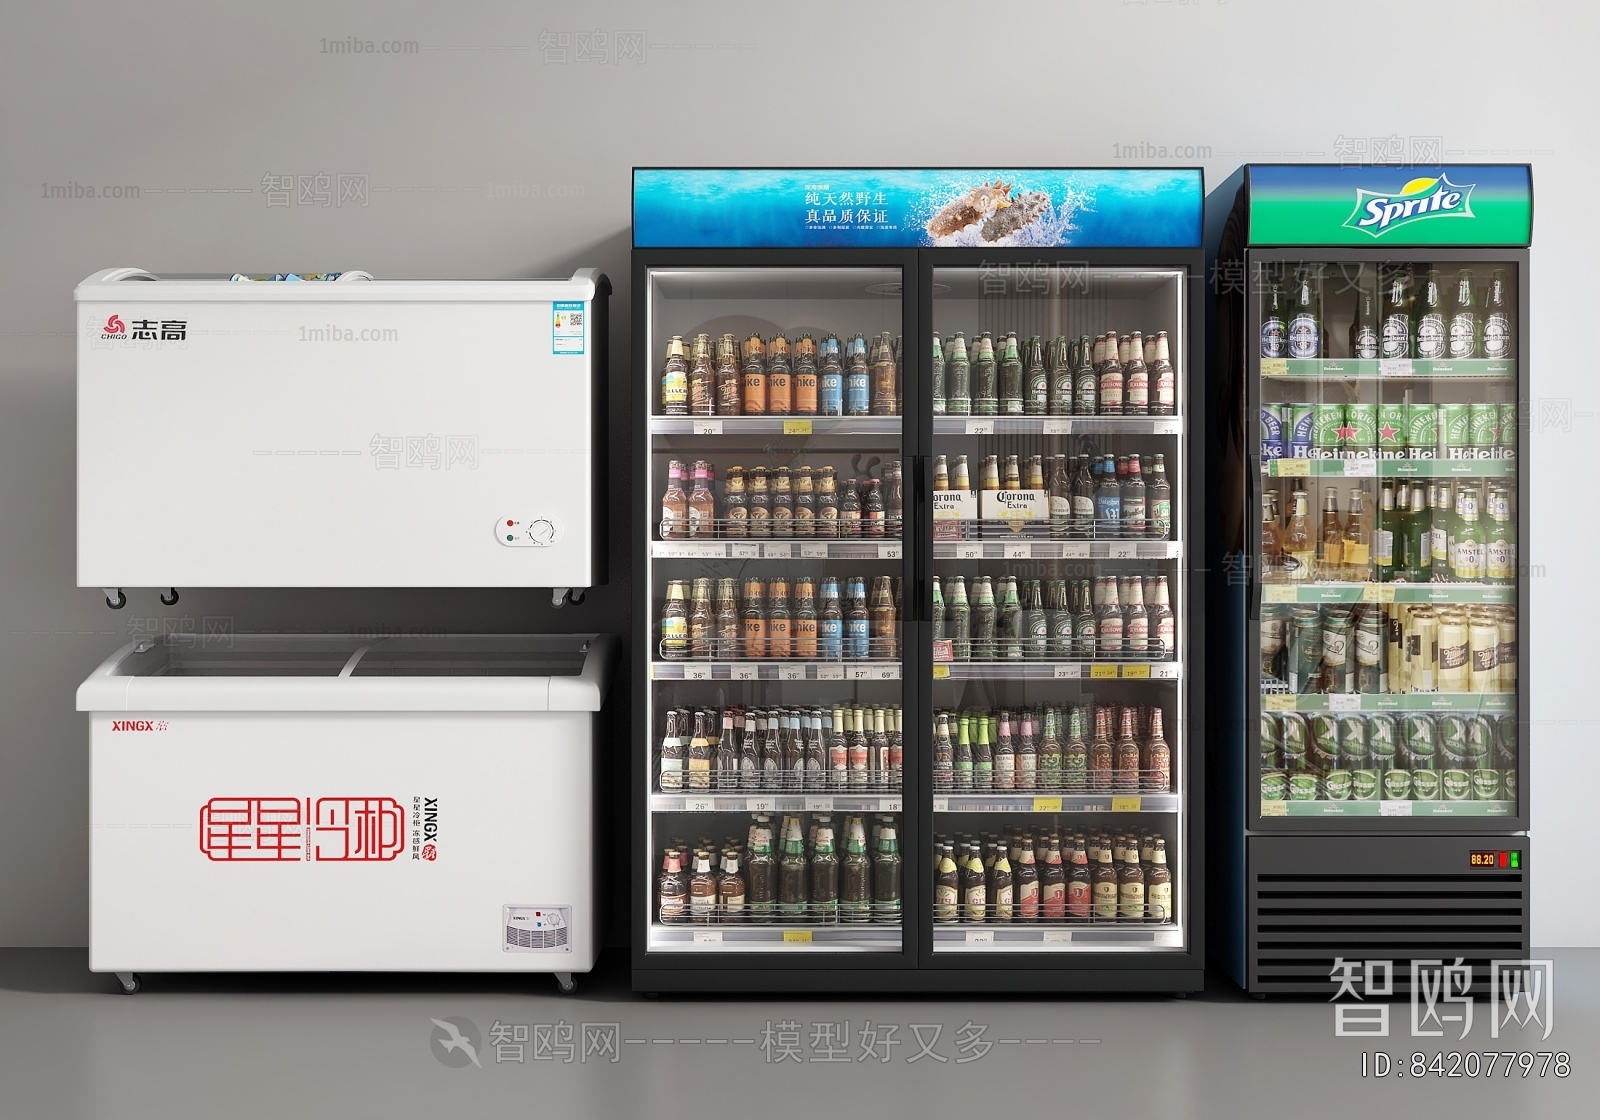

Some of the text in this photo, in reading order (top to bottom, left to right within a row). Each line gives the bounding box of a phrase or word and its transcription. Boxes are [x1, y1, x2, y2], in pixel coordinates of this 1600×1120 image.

[804, 191, 888, 206] 纯天然野生
[1357, 184, 1462, 230] Sprite
[804, 208, 888, 224] 真品质保证
[131, 319, 187, 341] 志高
[1265, 416, 1280, 436] BEER
[933, 493, 962, 502] orona
[996, 490, 1035, 503] Corona
[112, 720, 154, 731] XINGX
[424, 796, 438, 842] XINGX
[1471, 854, 1494, 865] 88.20
